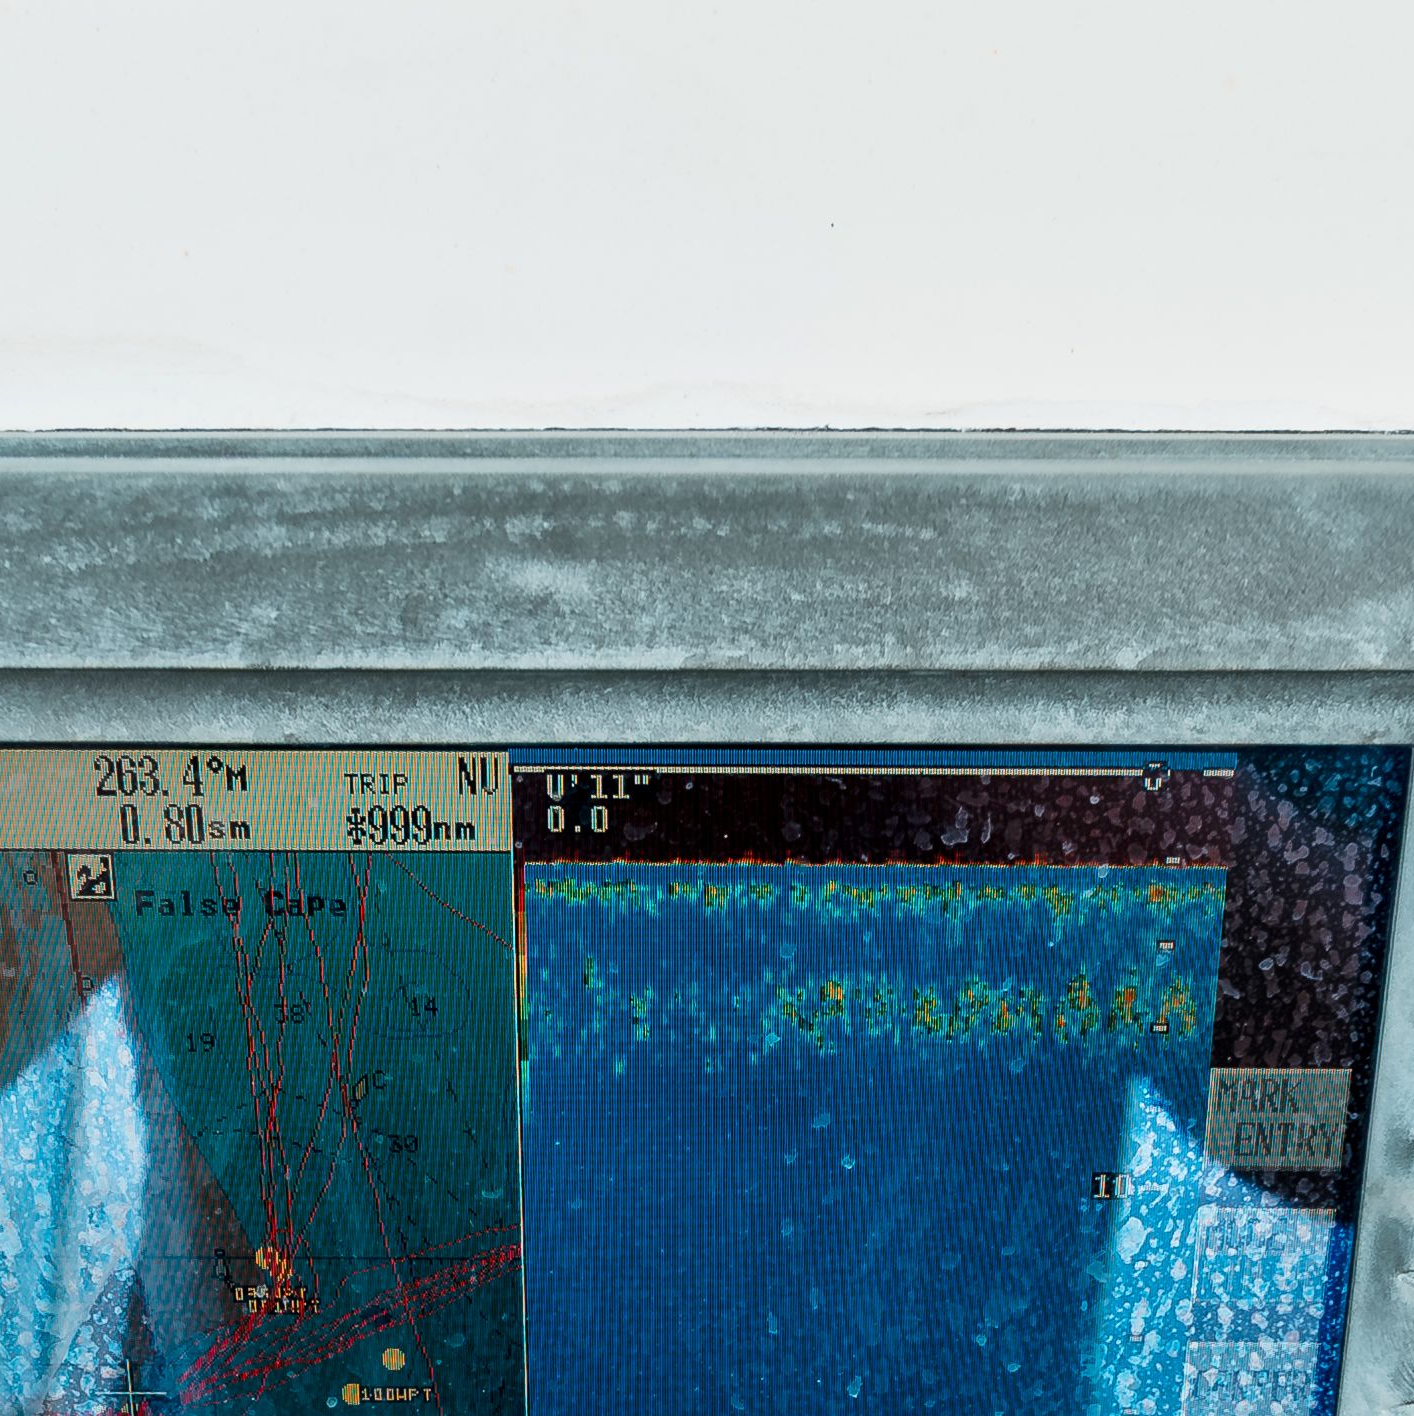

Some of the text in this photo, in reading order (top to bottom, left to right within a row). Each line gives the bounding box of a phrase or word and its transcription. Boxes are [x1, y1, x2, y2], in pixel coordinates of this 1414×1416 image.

[344, 773, 408, 795] TRIP
[458, 756, 499, 796] NU
[120, 804, 250, 845] 0.80sm
[547, 805, 608, 833] 0.0
[137, 890, 347, 919] False Cape
[1217, 1078, 1302, 1115] MARK
